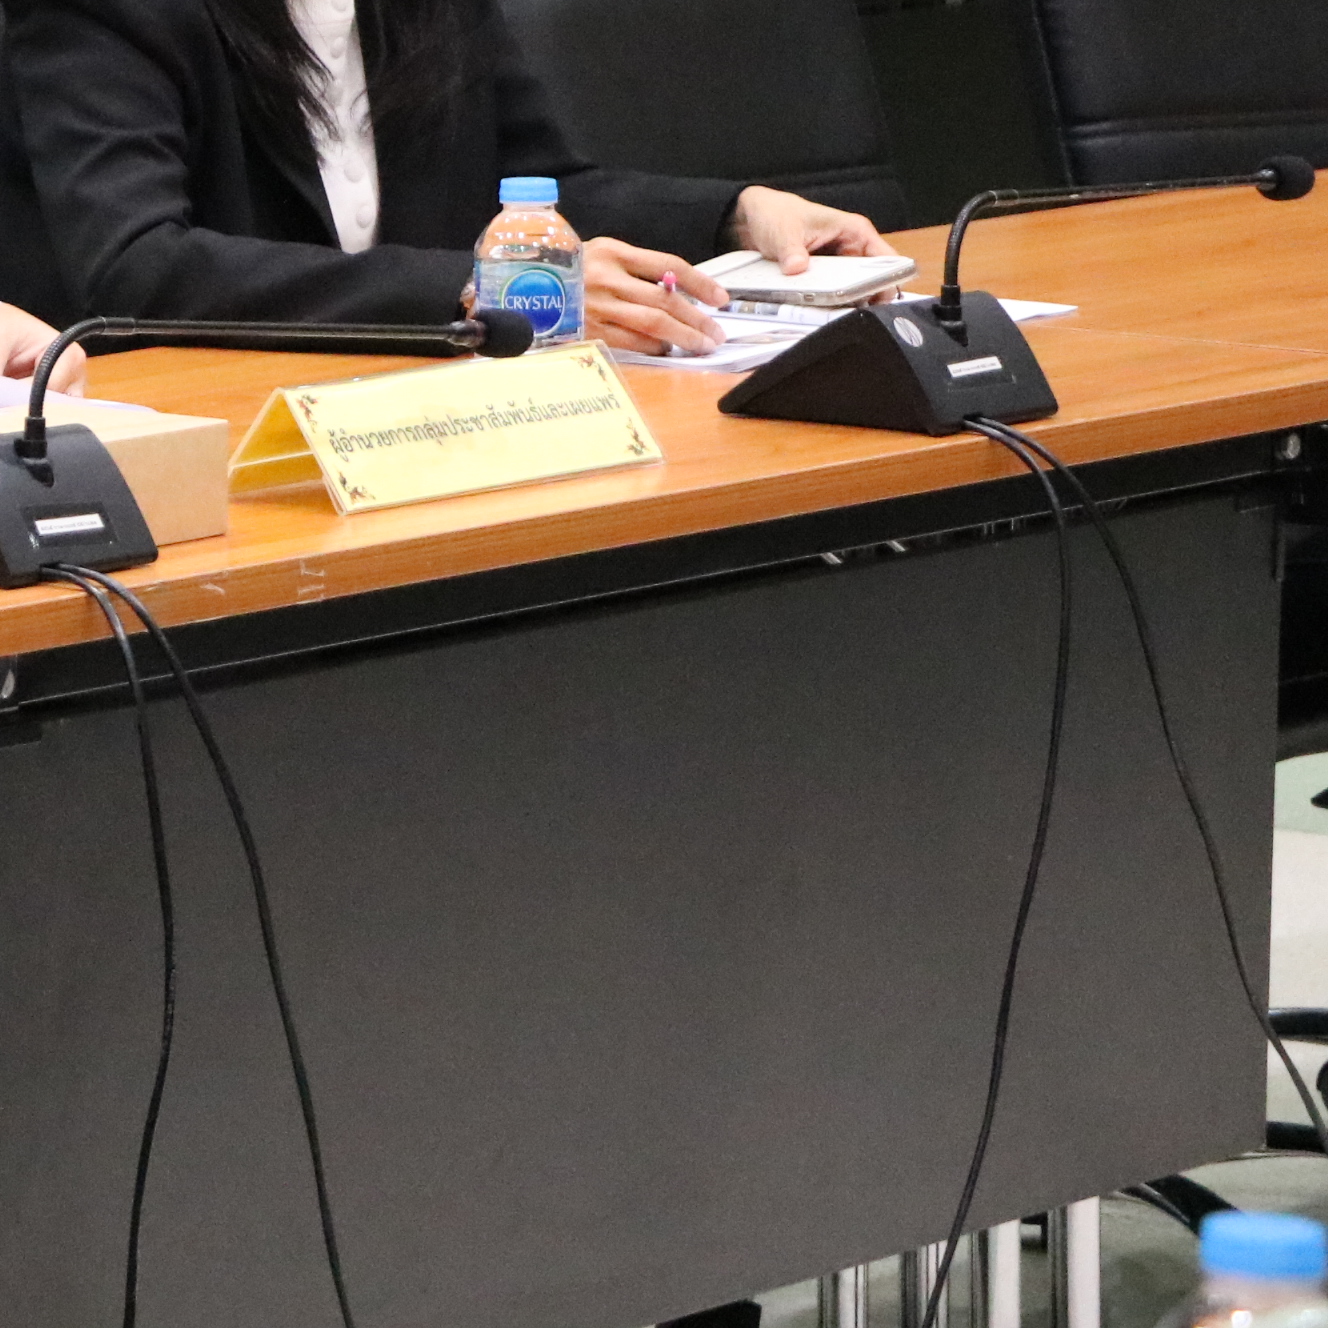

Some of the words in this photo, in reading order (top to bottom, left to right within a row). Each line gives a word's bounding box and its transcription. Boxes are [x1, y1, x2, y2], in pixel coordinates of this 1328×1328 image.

[504, 294, 563, 311] CRYSTAL
[327, 387, 621, 463] ผู้อำนวยการกลุ่มประชาสัมพันธ์และเผยแพร่
